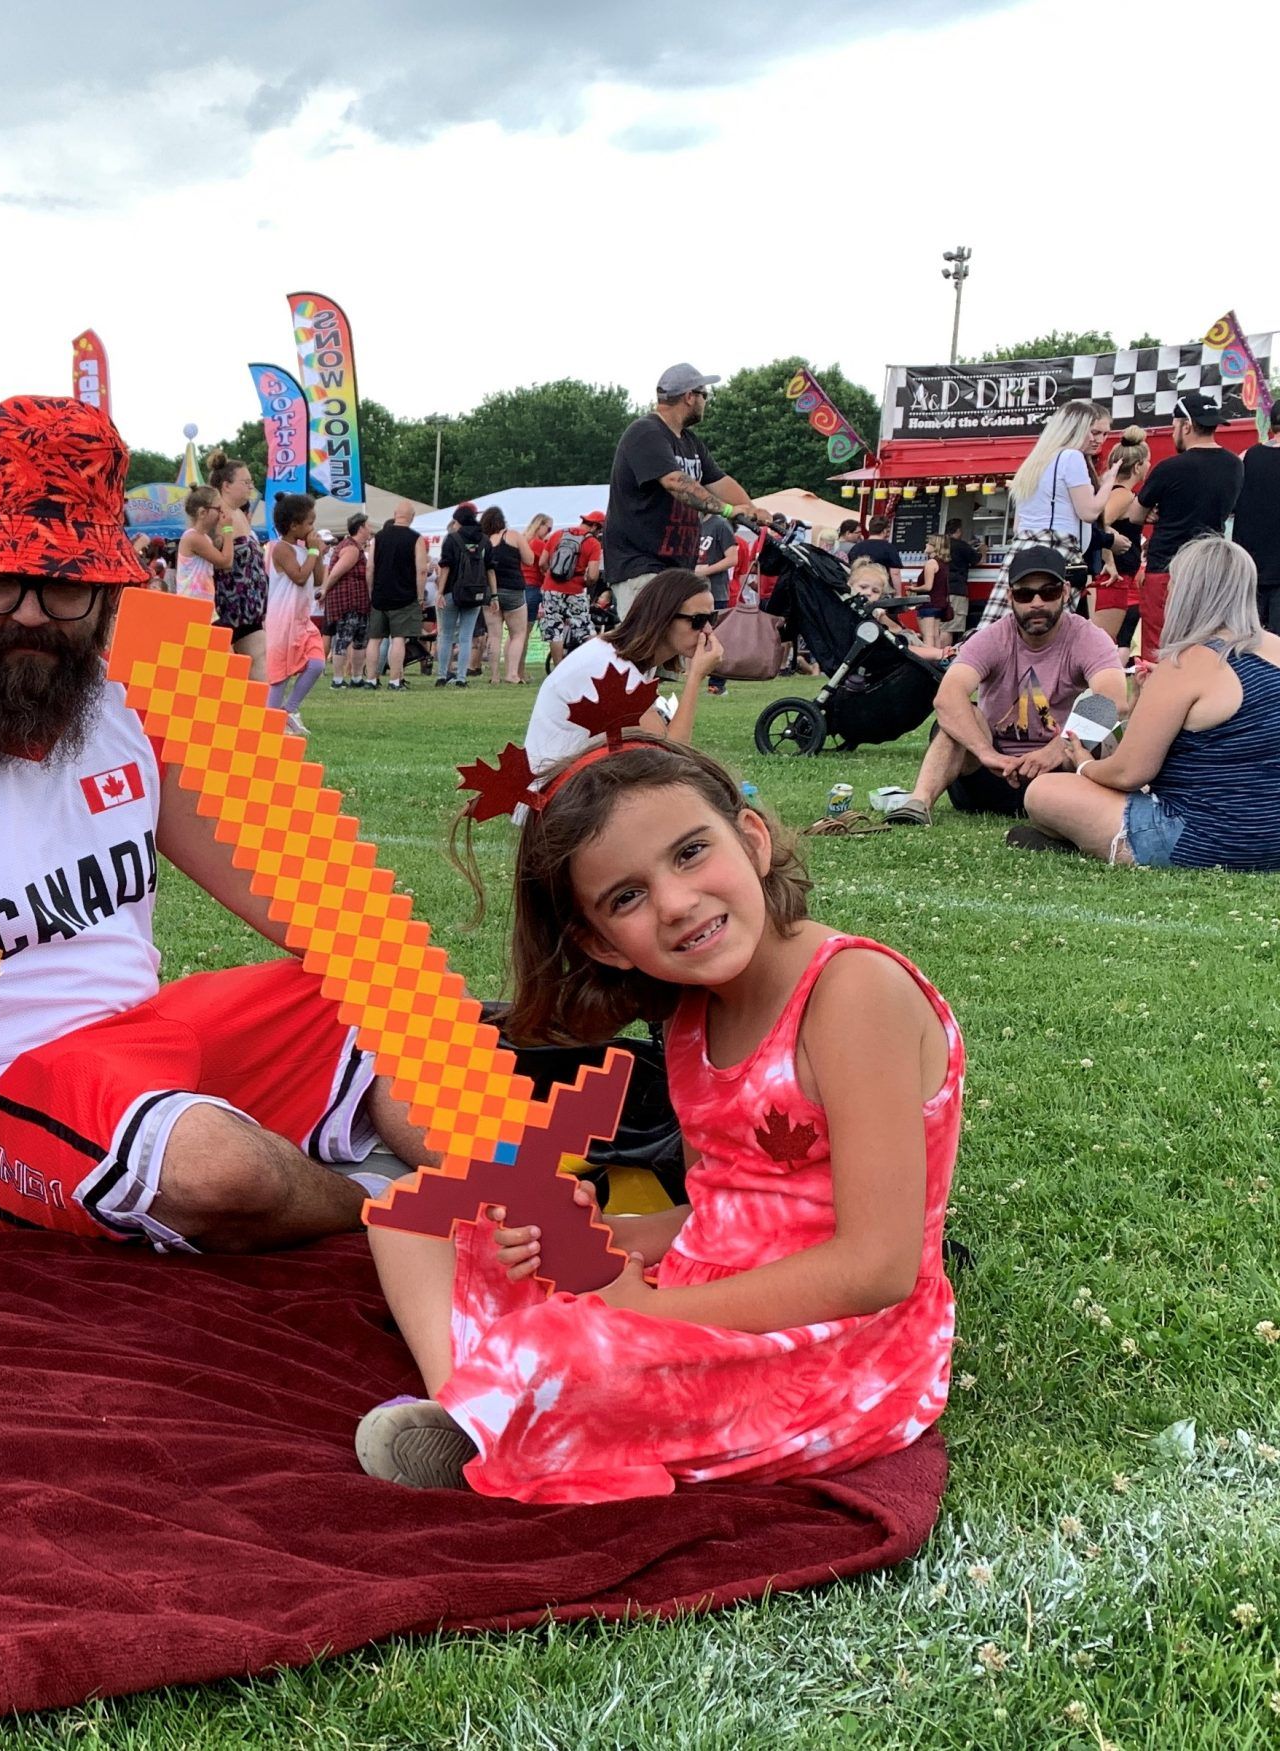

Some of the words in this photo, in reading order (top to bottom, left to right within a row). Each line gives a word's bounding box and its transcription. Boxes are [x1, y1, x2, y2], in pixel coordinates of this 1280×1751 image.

[908, 417, 942, 429] Home
[943, 416, 957, 428] of
[958, 416, 979, 428] the
[980, 413, 1025, 427] Golden
